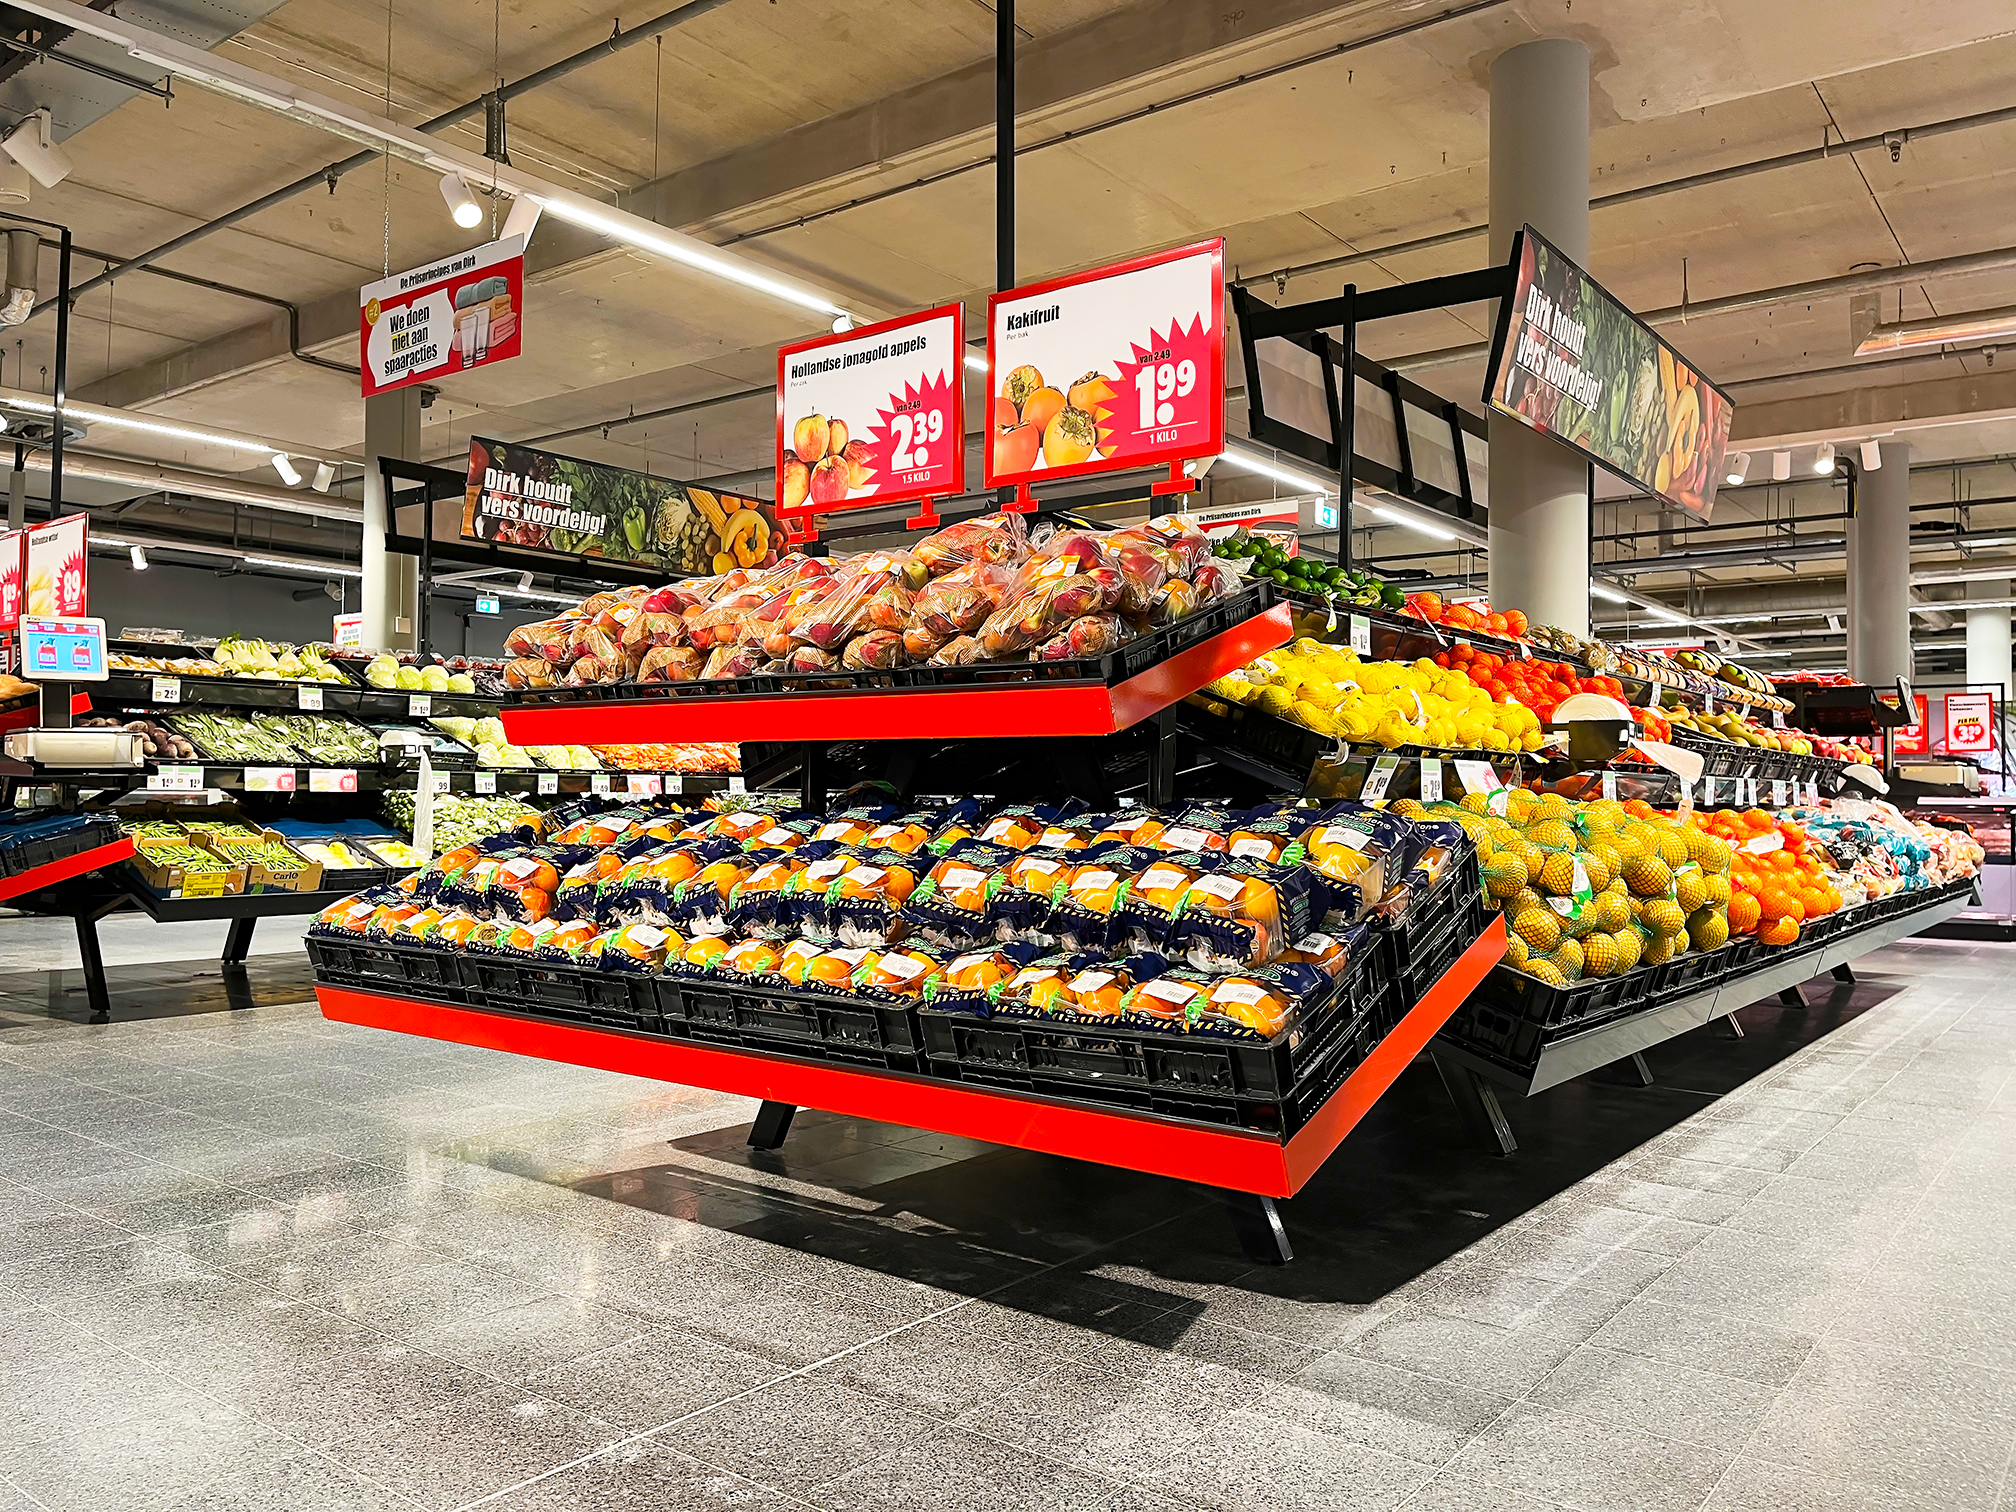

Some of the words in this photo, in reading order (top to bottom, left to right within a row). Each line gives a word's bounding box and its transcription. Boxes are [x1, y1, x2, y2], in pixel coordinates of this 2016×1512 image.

[400, 278, 408, 290] De
[450, 261, 463, 272] van
[463, 254, 476, 268] Dirk
[369, 306, 378, 318] #2
[389, 314, 404, 333] We
[406, 305, 430, 327] doen
[1006, 304, 1060, 331] Kakifruit
[1525, 281, 1553, 333] Dirk
[1551, 301, 1588, 357] houdt
[391, 331, 411, 353] niet
[411, 326, 429, 346] aan
[1006, 332, 1017, 341] Per
[384, 343, 438, 375] spaaracties
[791, 357, 841, 379] Hollandse
[842, 344, 889, 370] jonagold
[890, 335, 927, 358] appels
[1139, 353, 1153, 364] van
[1515, 331, 1547, 375] vers
[1545, 348, 1604, 414] voordelig!
[896, 402, 908, 412] van
[1149, 434, 1155, 445] 1
[1156, 429, 1178, 443] KILO
[484, 467, 521, 495] Dirk
[523, 475, 573, 504] houdt
[902, 473, 913, 485] 1.5
[913, 470, 931, 484] KILO
[481, 494, 521, 520] vers
[522, 503, 606, 537] voordelig!
[1240, 509, 1251, 517] van
[1250, 507, 1262, 516] Dirk
[63, 569, 81, 603] 89
